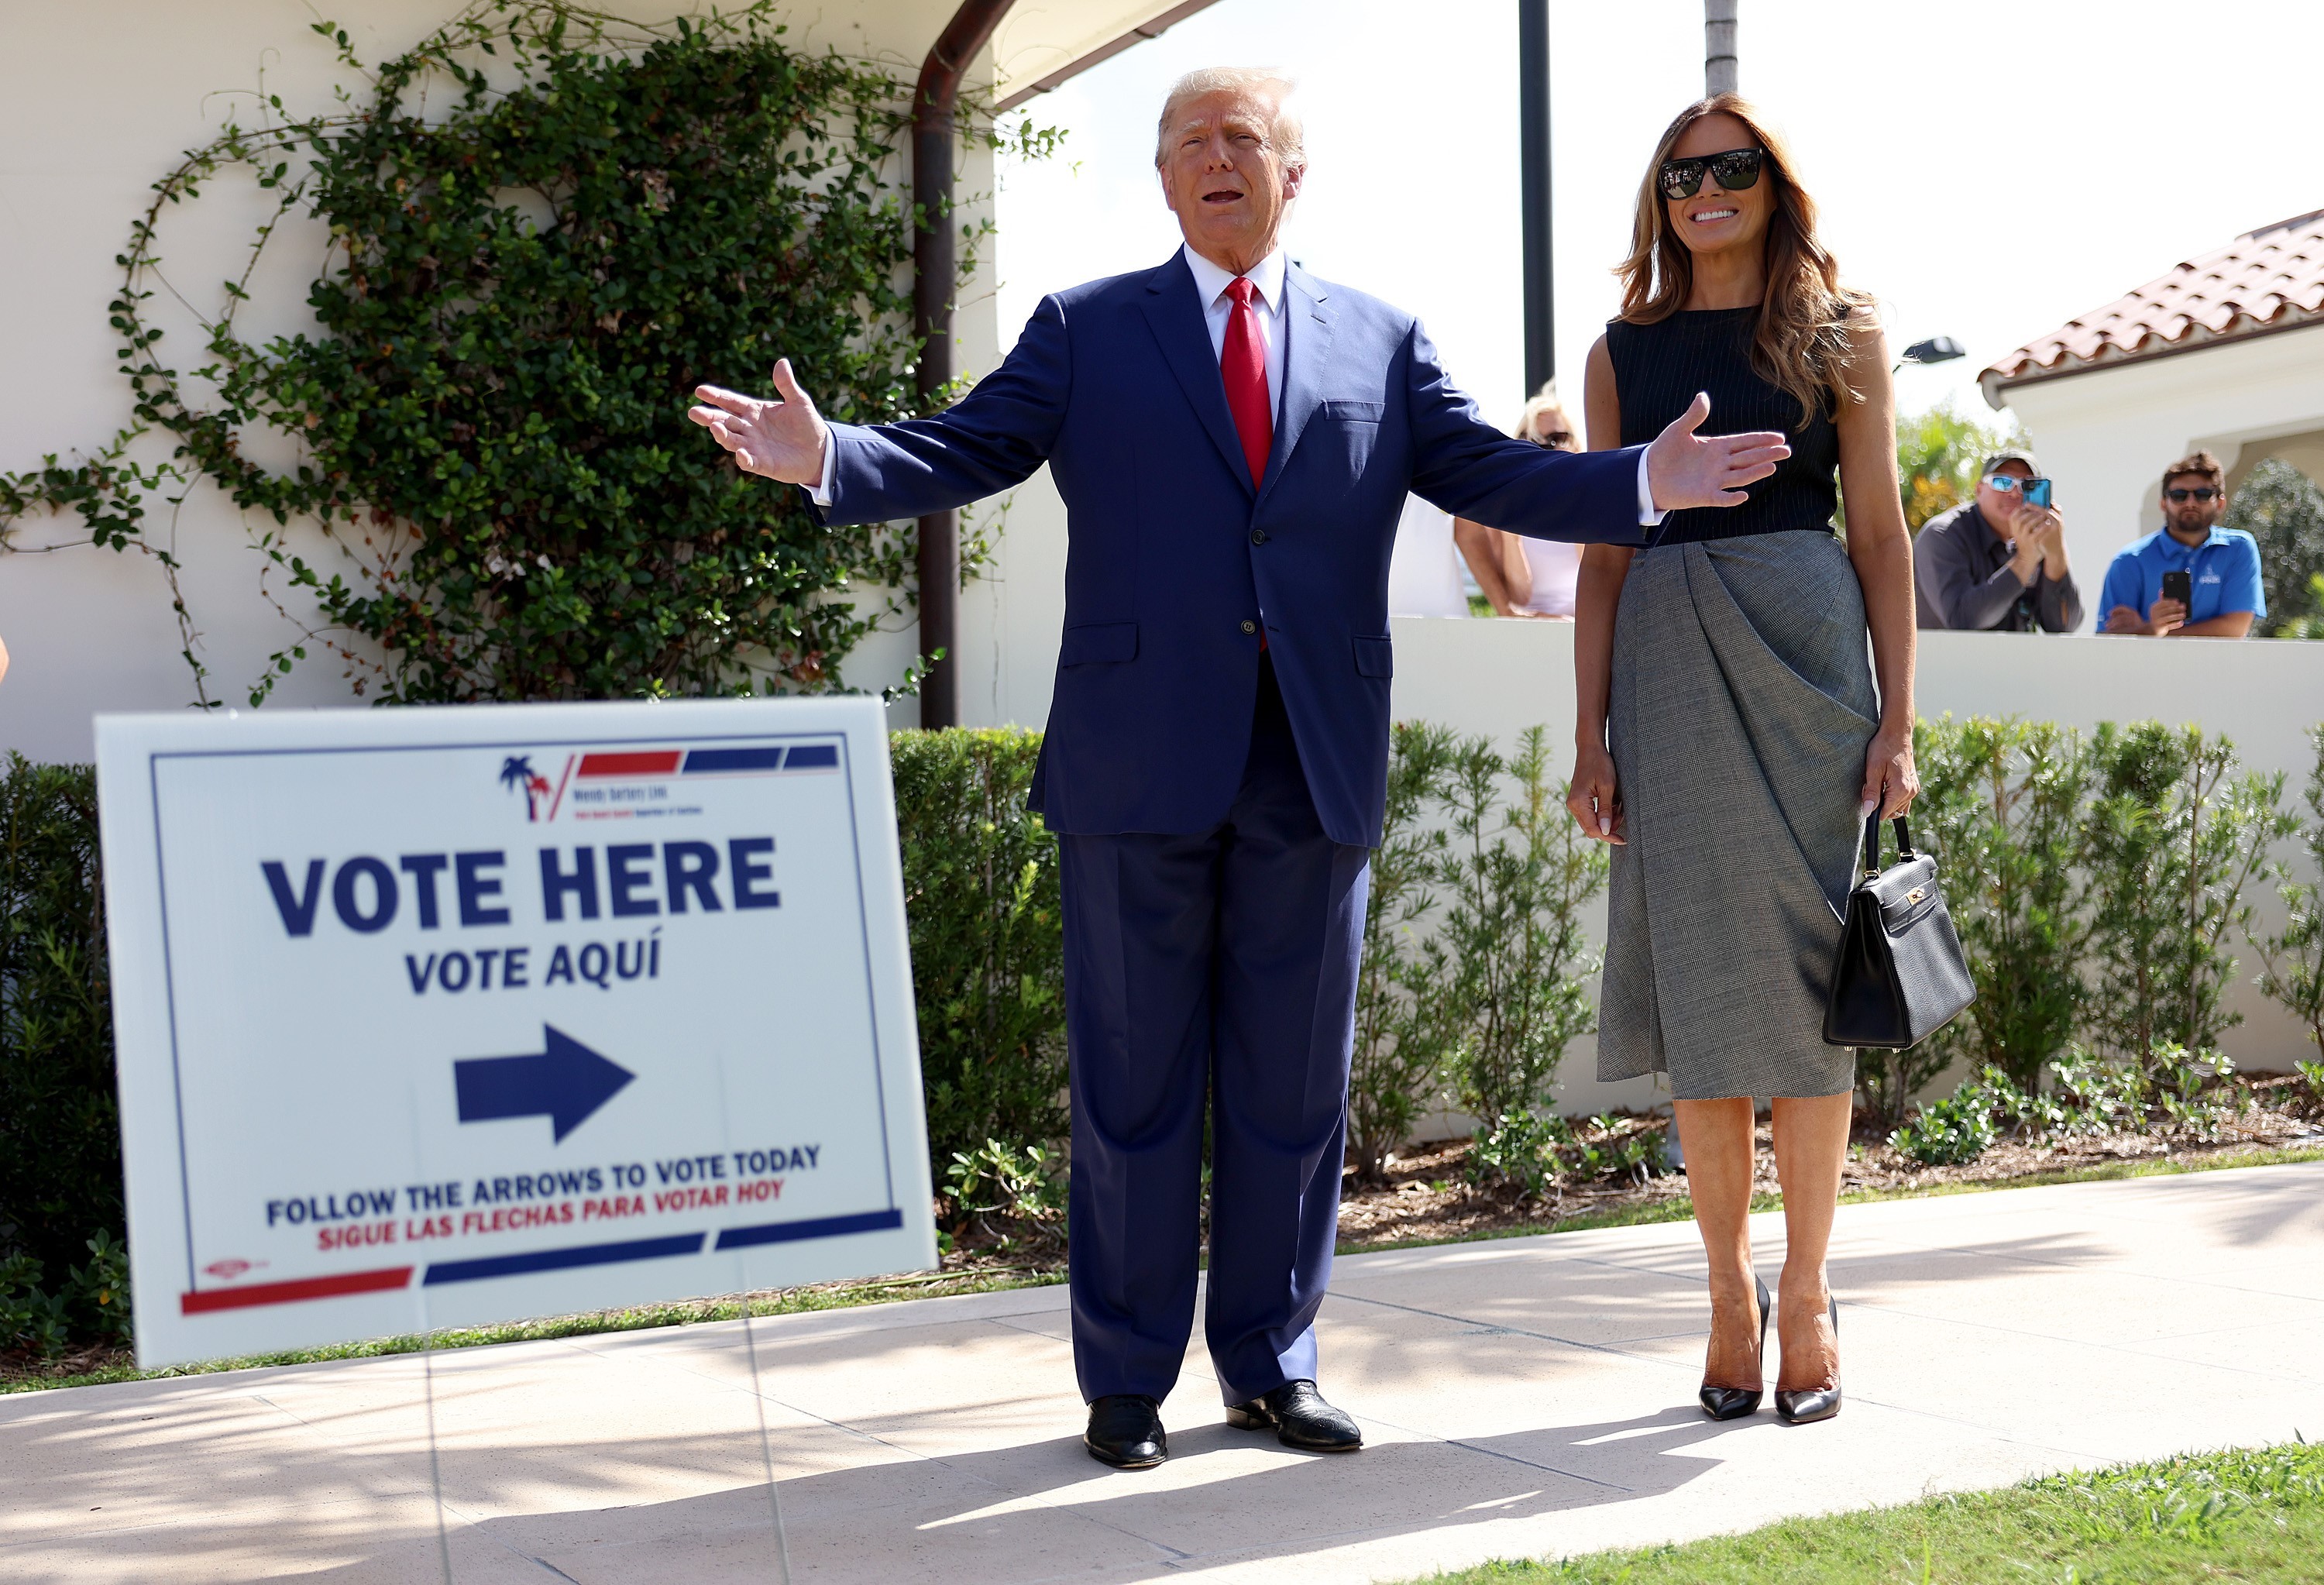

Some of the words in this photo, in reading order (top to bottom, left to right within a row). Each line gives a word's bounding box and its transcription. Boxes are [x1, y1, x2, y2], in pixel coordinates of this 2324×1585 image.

[260, 849, 513, 939] VOTE
[537, 837, 782, 924] HERE
[403, 945, 531, 996] VOTE
[543, 925, 662, 992] AQUÍ
[265, 1188, 397, 1228] FOLLOW
[405, 1181, 463, 1212] THE
[472, 1167, 604, 1206] ARROWS
[610, 1162, 647, 1191] TO
[655, 1153, 727, 1185] VOTE
[732, 1144, 821, 1178] TODAY
[317, 1219, 397, 1253] SIGUE
[404, 1214, 454, 1242] LAS
[462, 1200, 575, 1236] FLECHAS
[582, 1193, 646, 1222] PARA
[653, 1184, 729, 1215] VOTAR
[737, 1178, 785, 1204] HOY
